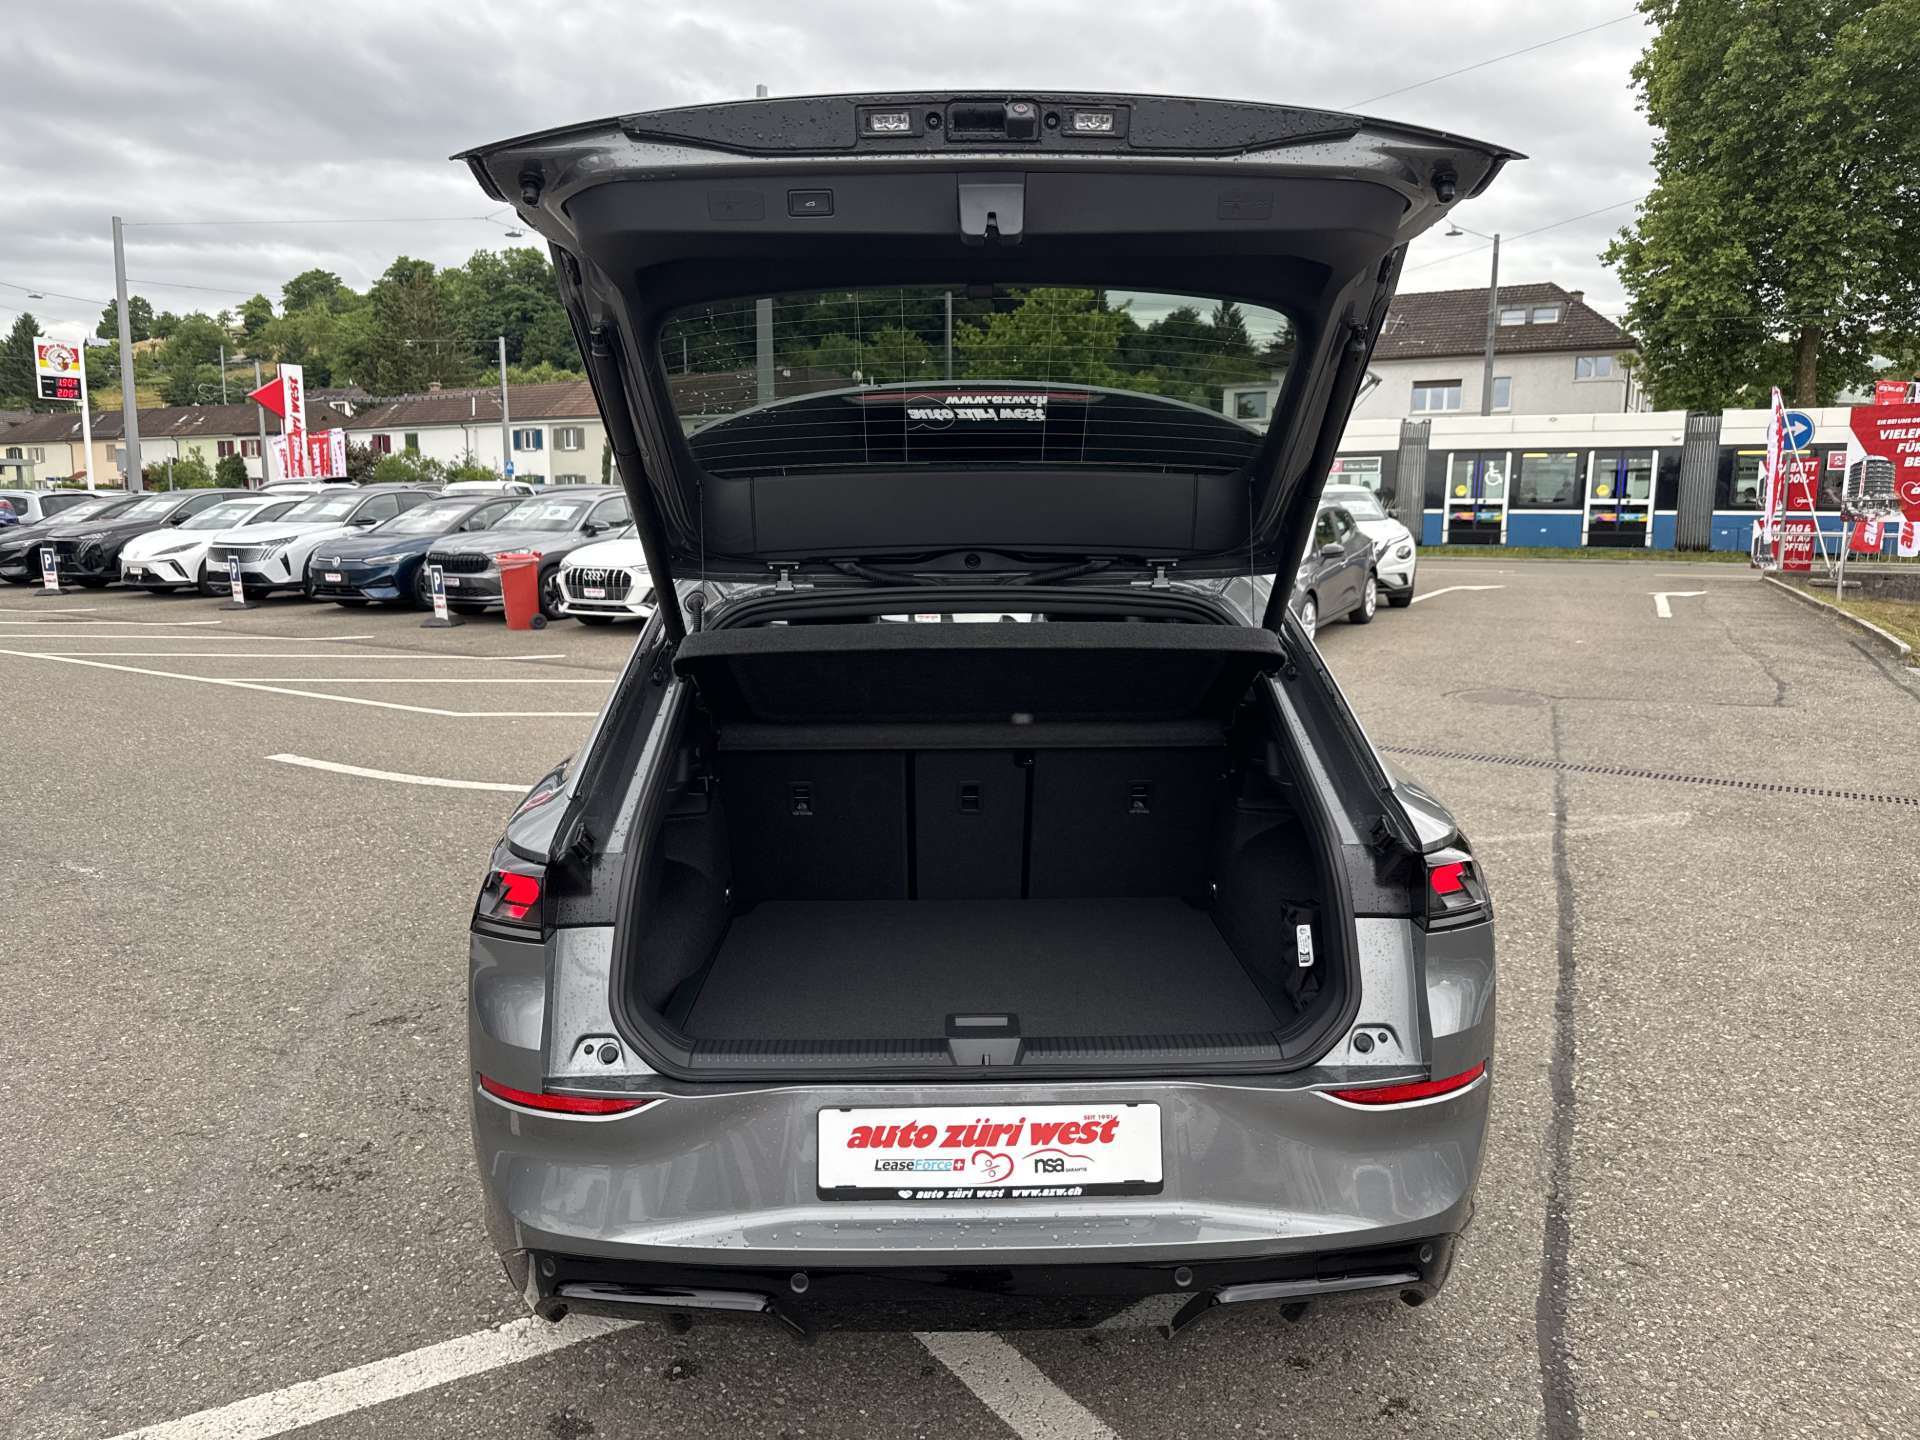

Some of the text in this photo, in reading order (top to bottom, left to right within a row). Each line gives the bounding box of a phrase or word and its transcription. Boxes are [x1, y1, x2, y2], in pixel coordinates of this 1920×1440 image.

[289, 376, 301, 413] west
[43, 554, 52, 569] P
[231, 561, 238, 579] P
[433, 572, 441, 592] P
[846, 1115, 1120, 1149] auto züri west
[1034, 1157, 1065, 1174] nsa
[916, 1187, 1082, 1199] auto züri west www.azw.ch
